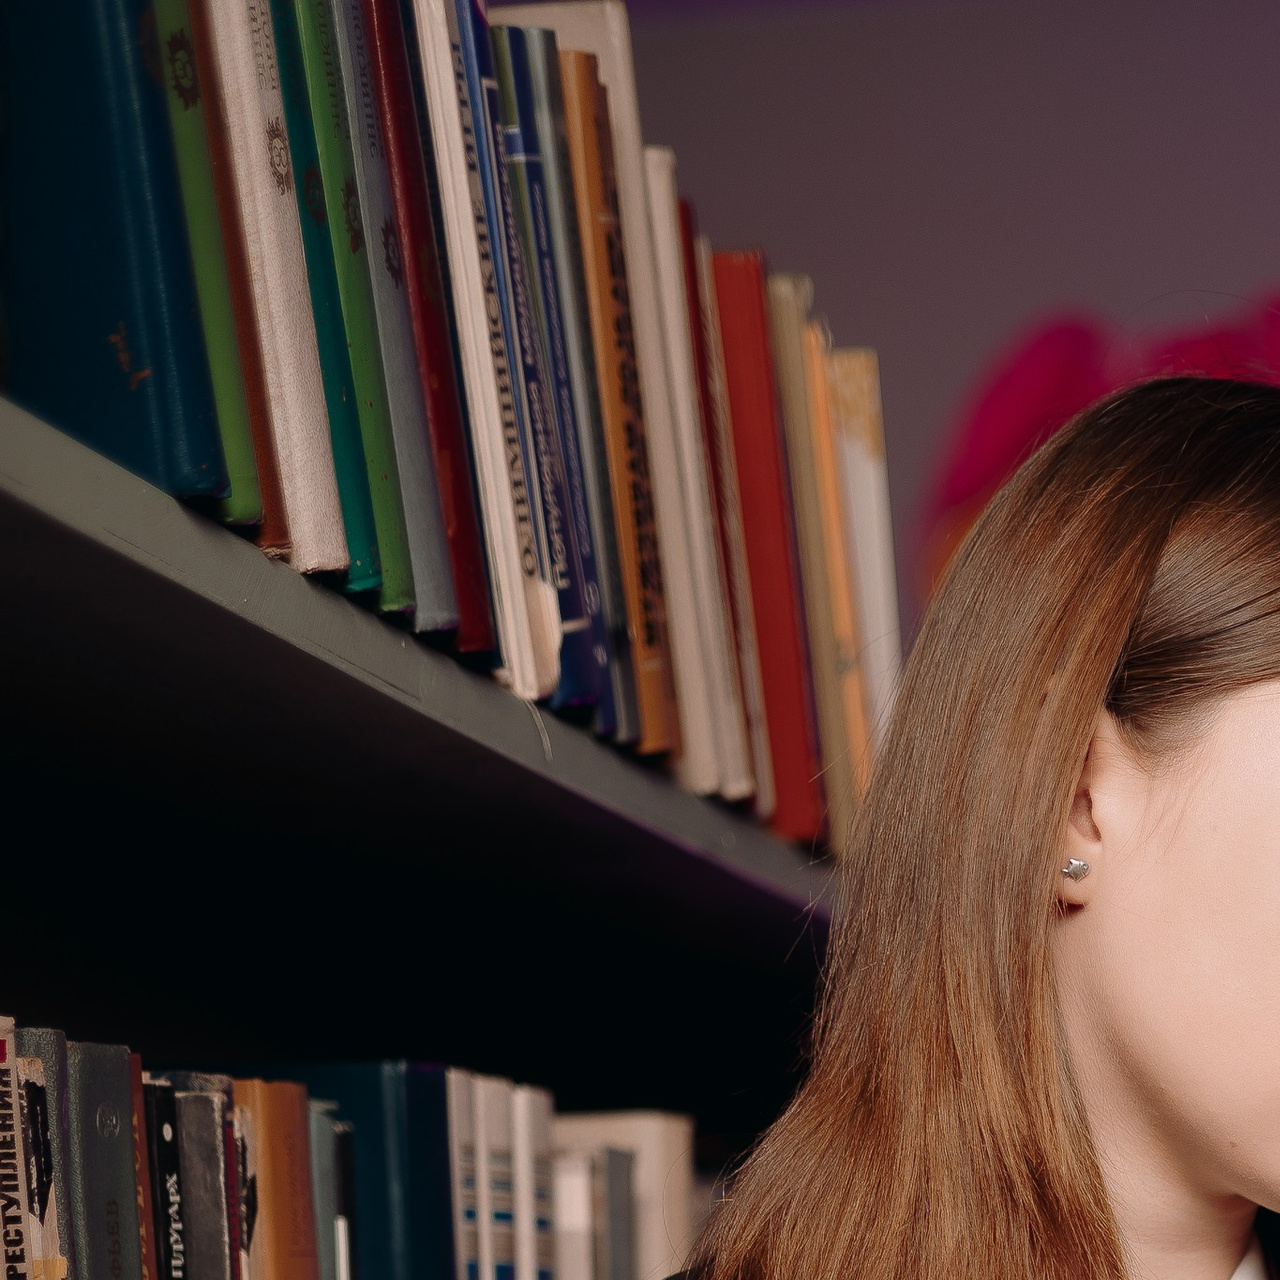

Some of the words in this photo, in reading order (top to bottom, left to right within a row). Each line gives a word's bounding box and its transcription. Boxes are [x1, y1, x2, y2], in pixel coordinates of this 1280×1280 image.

[451, 42, 476, 172] ИГРЫ
[472, 199, 536, 578] ОЛИМПИЙСКИЕ
[165, 1173, 186, 1279] ПЛУТАРХ
